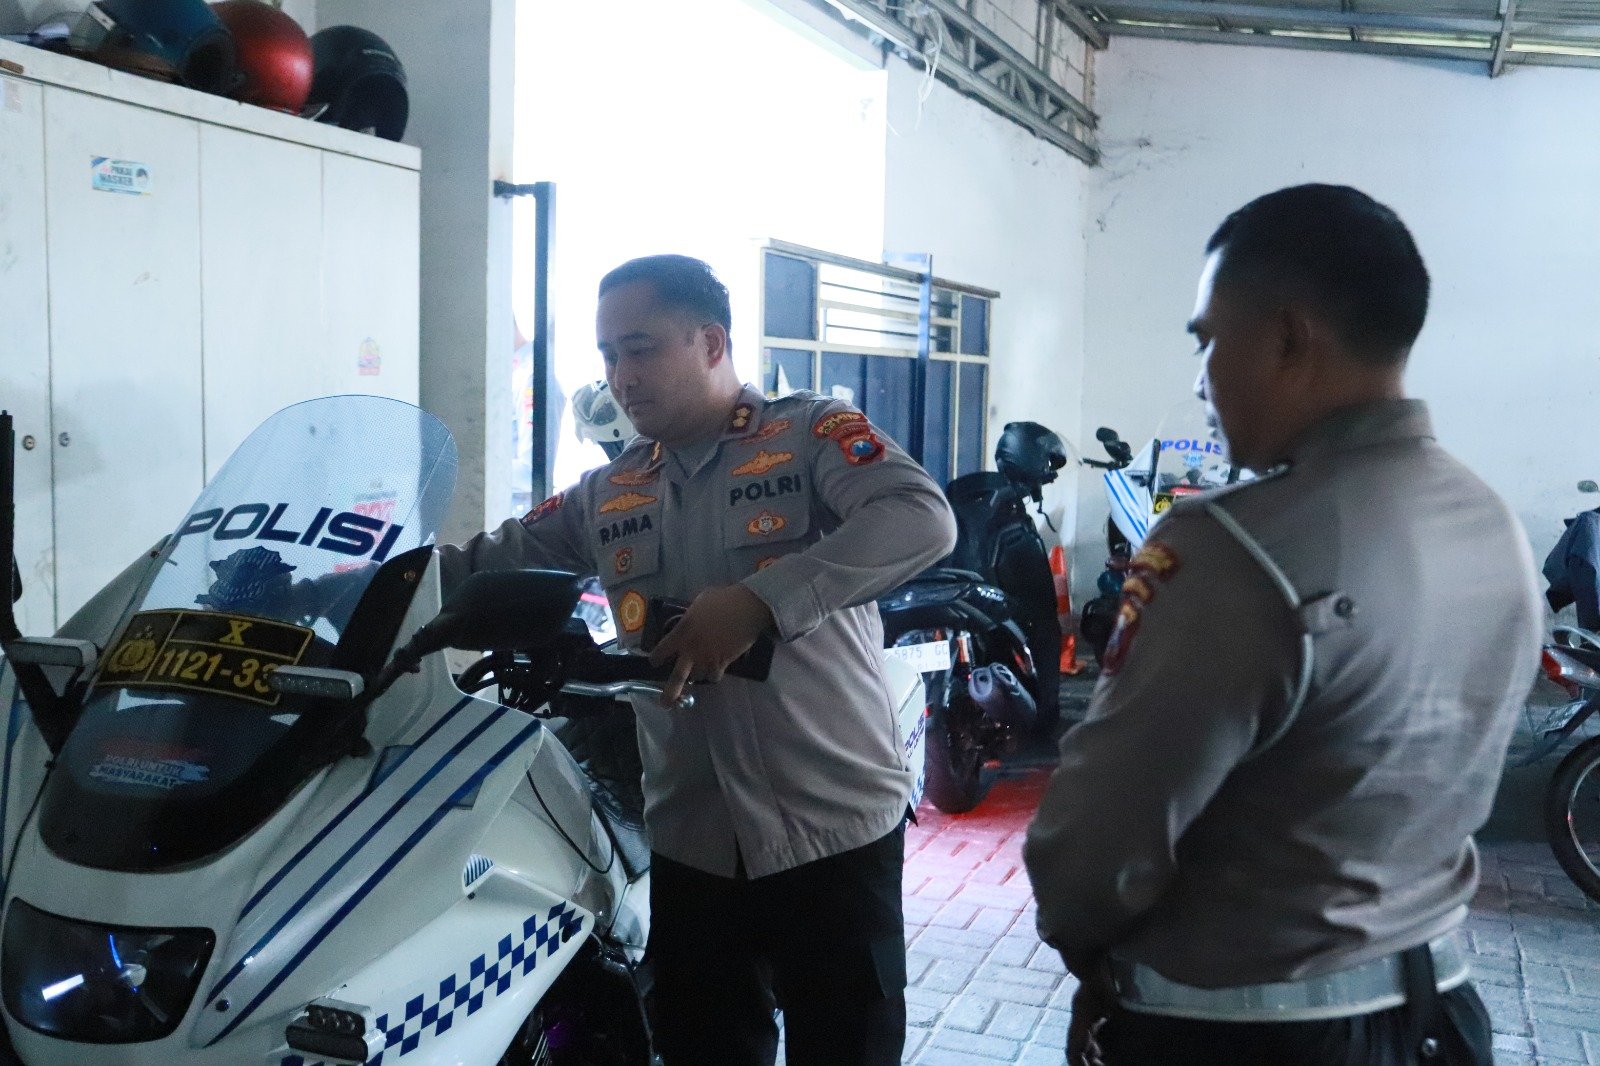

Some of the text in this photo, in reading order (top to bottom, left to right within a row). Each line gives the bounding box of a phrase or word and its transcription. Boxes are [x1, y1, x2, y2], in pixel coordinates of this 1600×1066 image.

[1160, 439, 1222, 455] POLIS
[730, 474, 801, 506] POLRI
[179, 503, 404, 563] POLISI
[599, 514, 652, 546] RAMA
[219, 619, 252, 646] X
